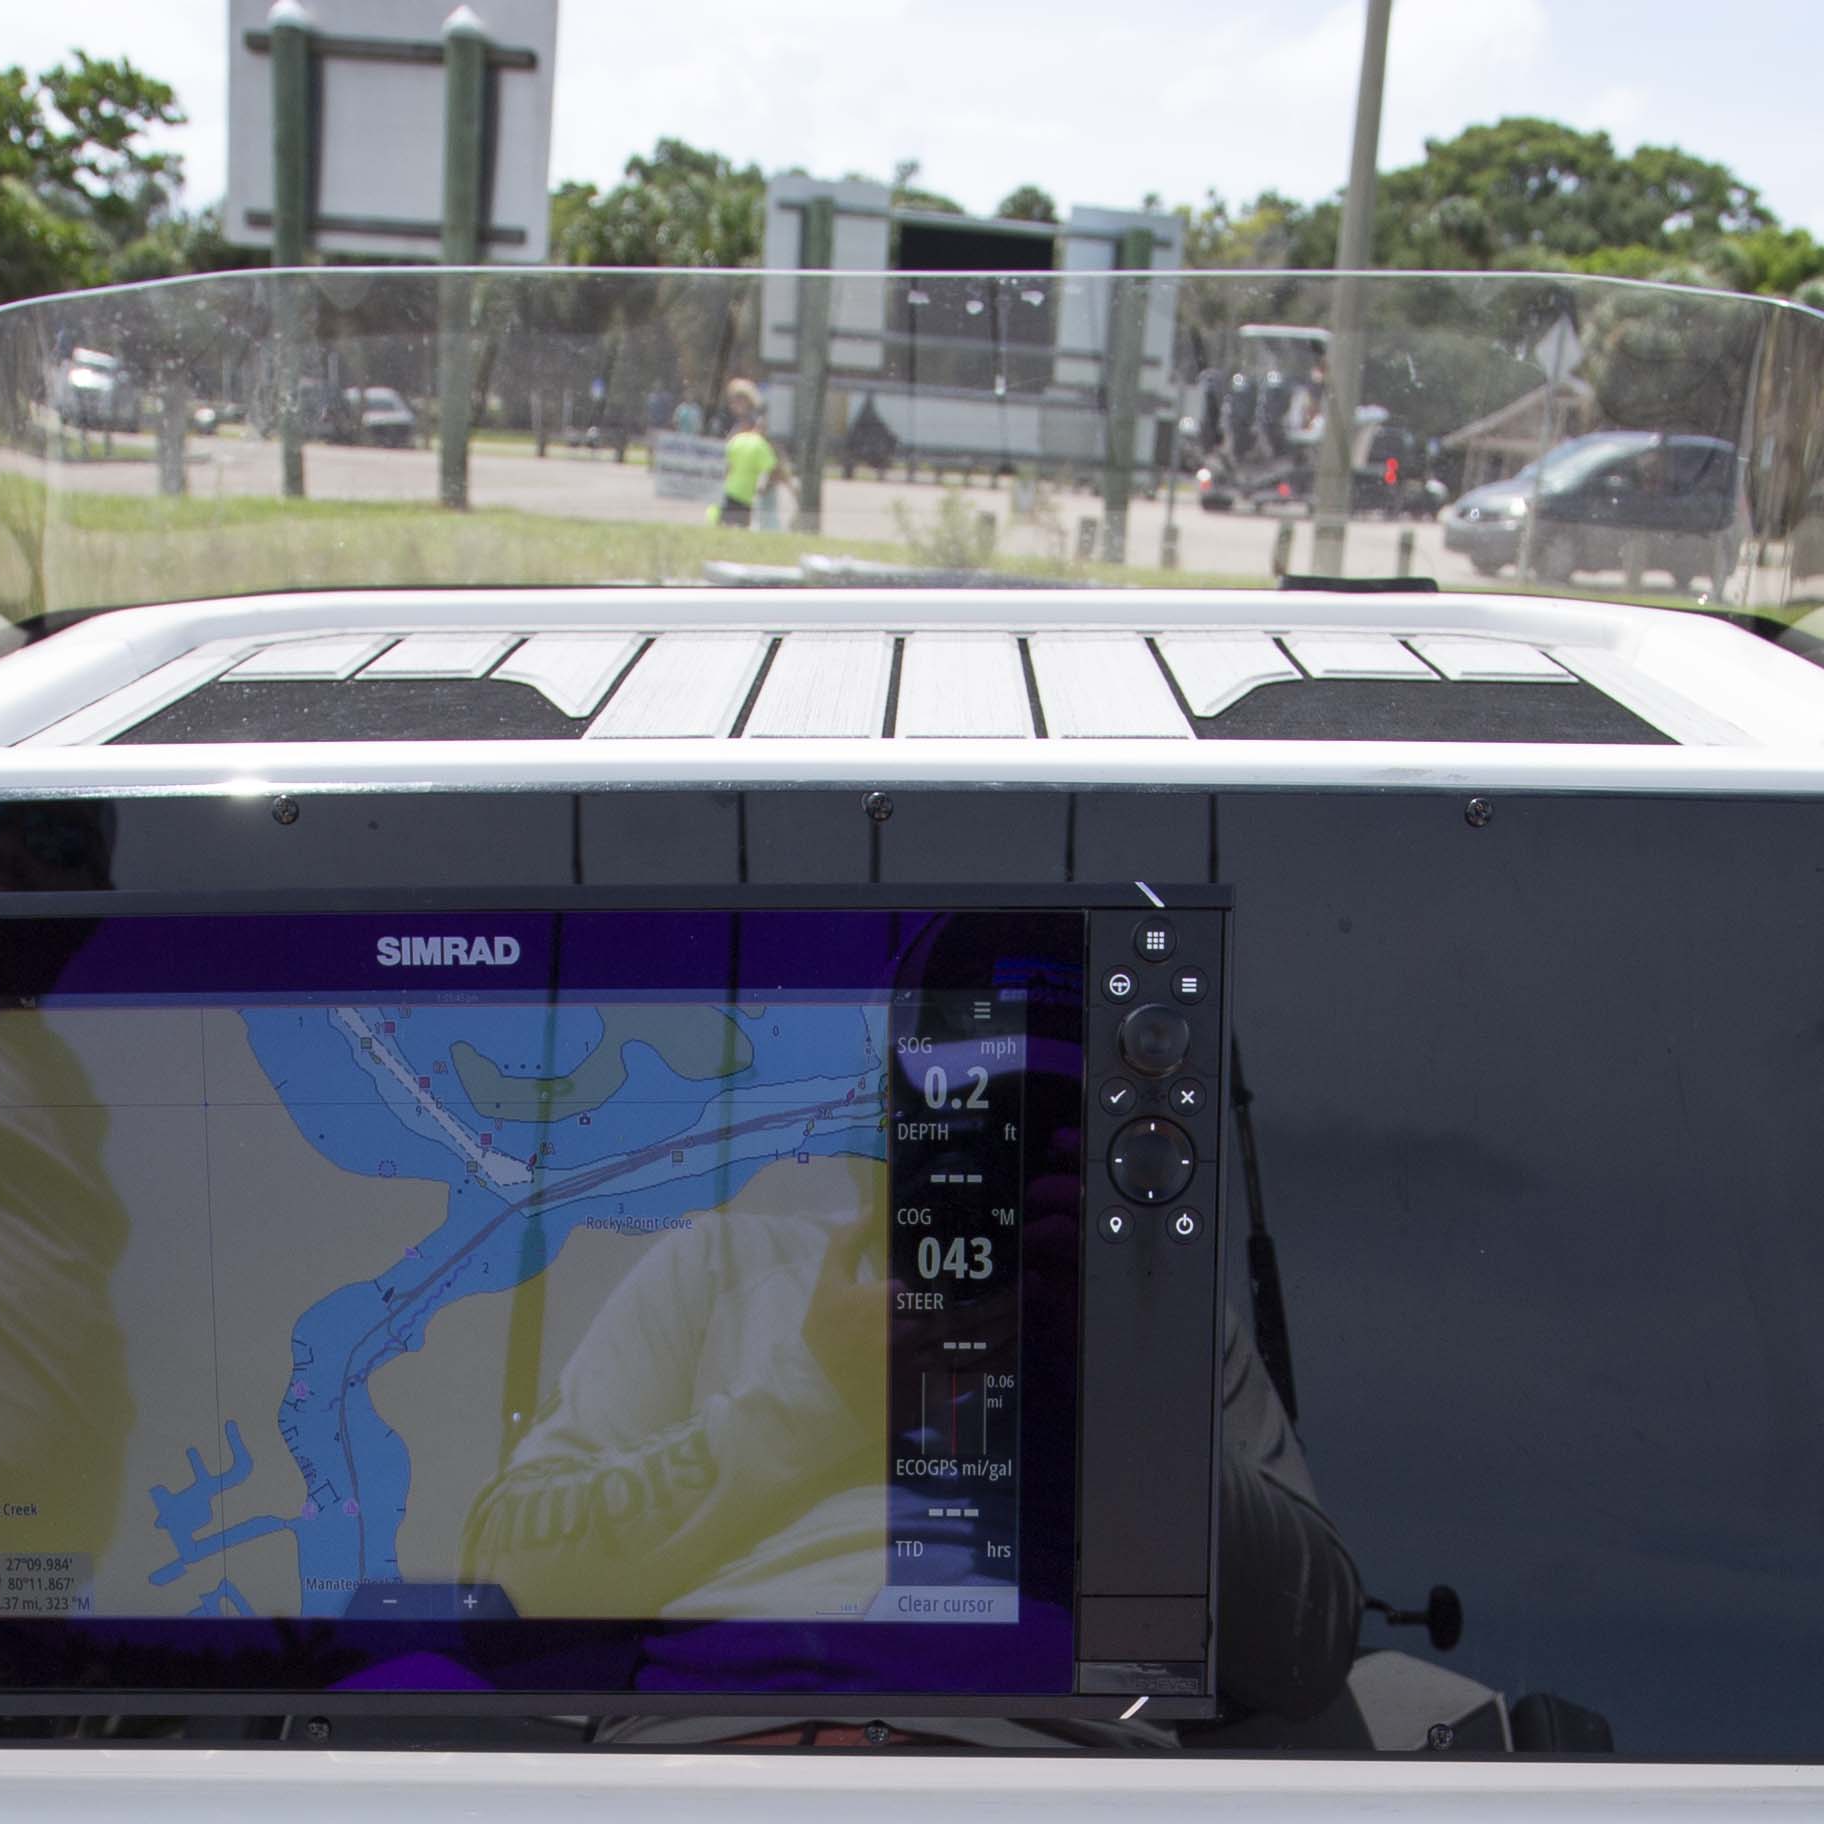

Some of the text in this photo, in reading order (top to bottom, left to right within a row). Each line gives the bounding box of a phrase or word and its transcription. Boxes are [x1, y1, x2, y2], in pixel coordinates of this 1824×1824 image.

[376, 936, 521, 967] SIMRAD
[897, 1036, 1017, 1060] SOG mph
[925, 1066, 989, 1110] 0.2
[897, 1122, 1017, 1142] DEPTH ft
[585, 1216, 693, 1232] Rocky Point Cove
[897, 1208, 1015, 1225] COG °M
[917, 1236, 993, 1280] 043
[896, 1292, 944, 1311] STEER
[987, 1375, 1015, 1389] 0.06
[987, 1395, 1003, 1409] mi
[895, 1458, 1012, 1481] ECOGPS mi/gal
[3, 1503, 38, 1517] Creek
[895, 1540, 1012, 1558] TTD hrs
[47, 1597, 69, 1611] 323
[897, 1595, 994, 1613] Clear cursor
